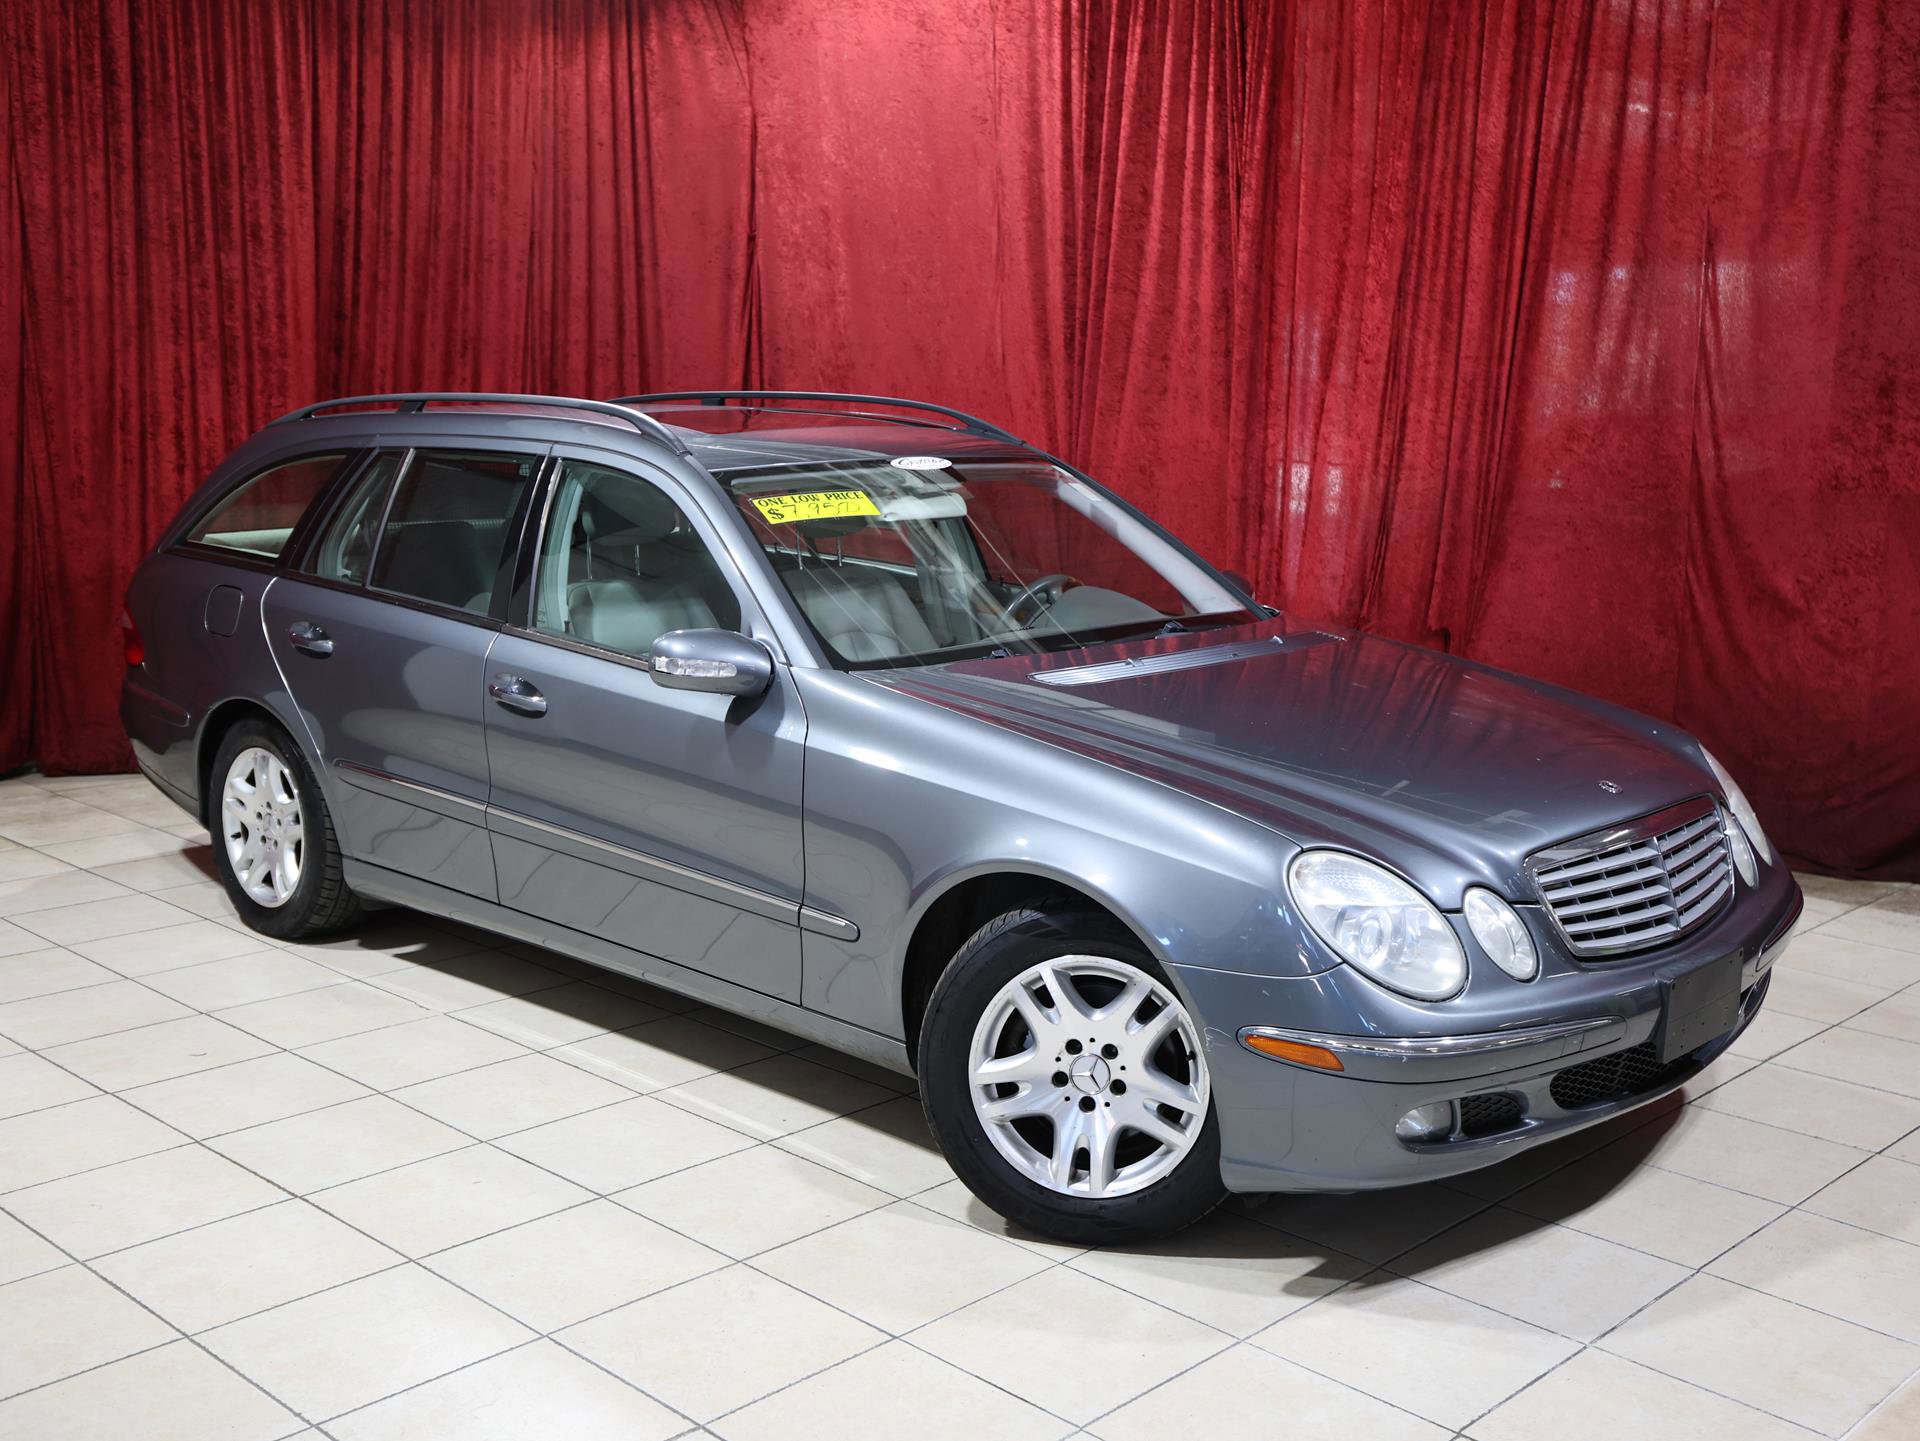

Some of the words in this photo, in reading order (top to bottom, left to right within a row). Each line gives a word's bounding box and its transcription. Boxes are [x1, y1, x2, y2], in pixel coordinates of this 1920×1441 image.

[758, 497, 788, 507] ONE
[790, 494, 820, 503] LOW
[823, 491, 864, 501] PRICE
